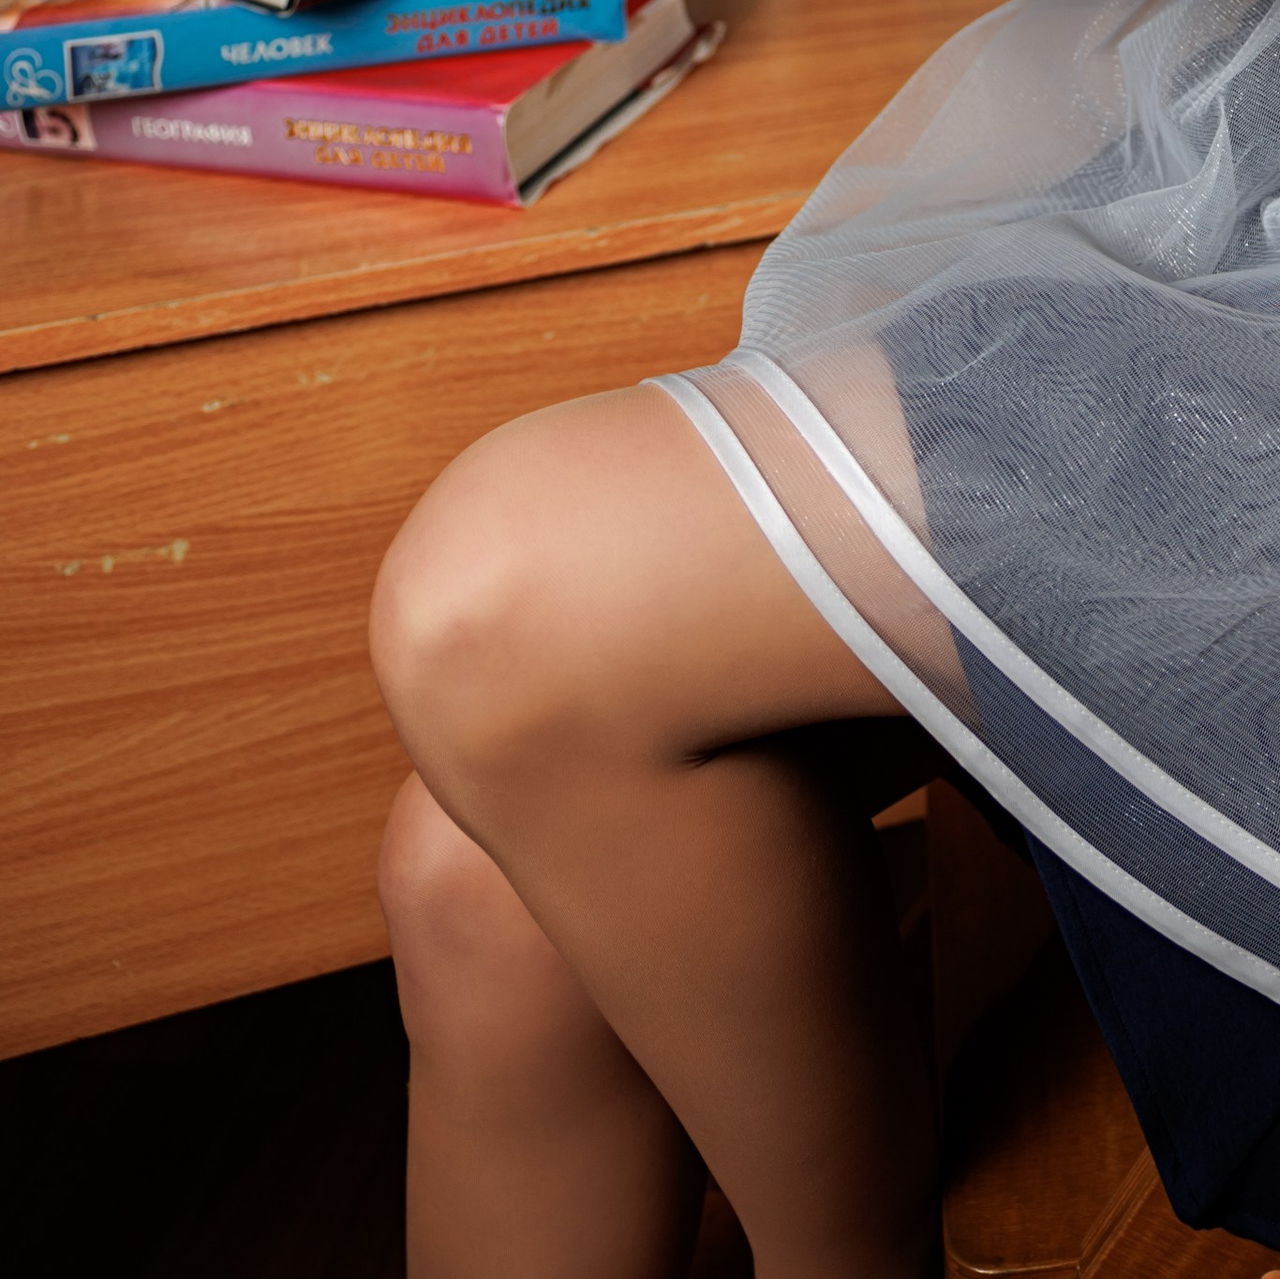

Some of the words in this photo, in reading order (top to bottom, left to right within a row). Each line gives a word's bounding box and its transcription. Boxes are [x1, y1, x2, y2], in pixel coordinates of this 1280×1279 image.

[220, 32, 333, 65] ЧЕЛОВЕК
[416, 29, 469, 54] ДЛЯ
[478, 18, 558, 46] ДЕТЕЙ
[131, 116, 253, 147] ГЕОГРАФИЯ
[284, 118, 473, 155] ЭНЦИКЛОПЕДИЯ
[315, 145, 364, 167] ДЛЯ
[371, 150, 446, 174] ДЕТЕЙ
